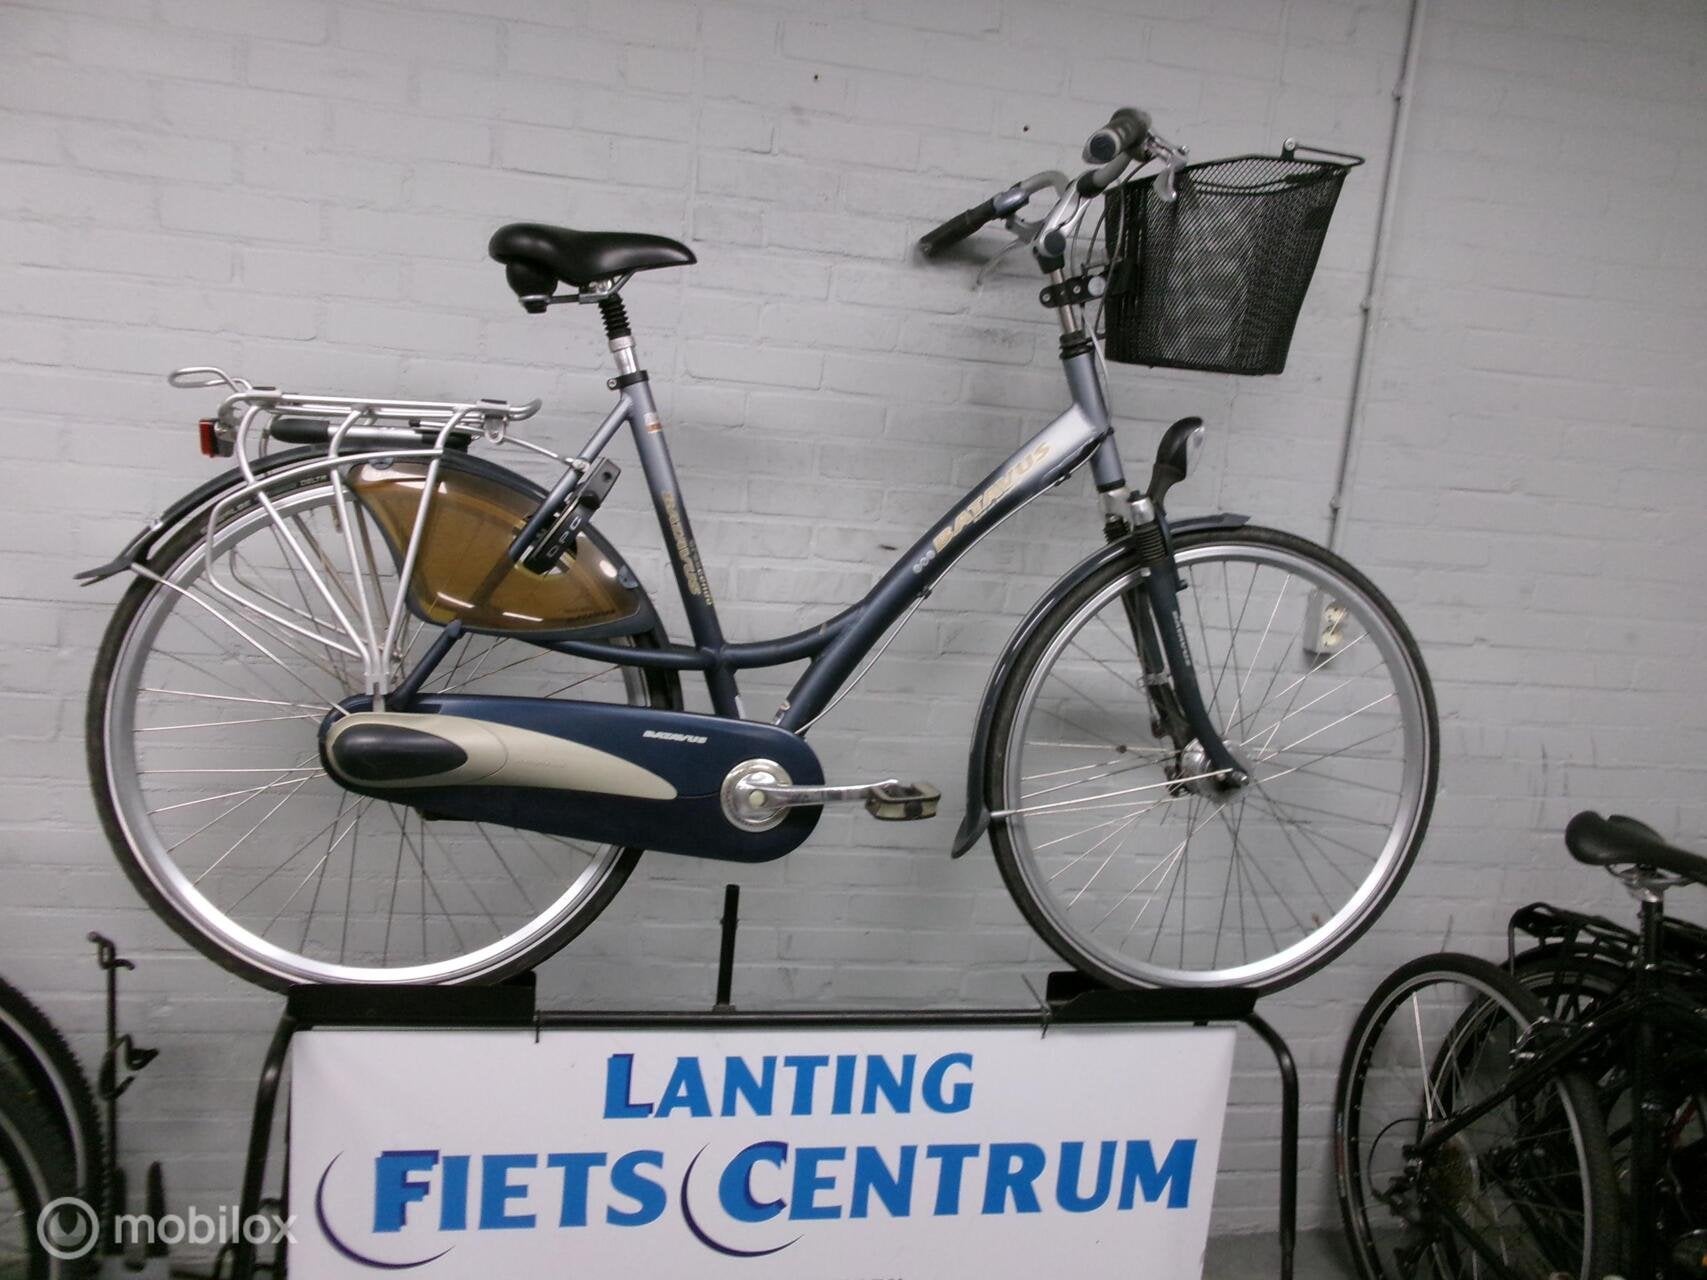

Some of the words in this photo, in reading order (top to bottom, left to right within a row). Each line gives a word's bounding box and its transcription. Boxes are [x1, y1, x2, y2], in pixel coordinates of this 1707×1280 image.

[932, 441, 1052, 553] BATAVUS
[603, 1052, 975, 1121] LANTING
[373, 1149, 668, 1234] FIETS
[718, 1139, 1198, 1225] CENTRUM
